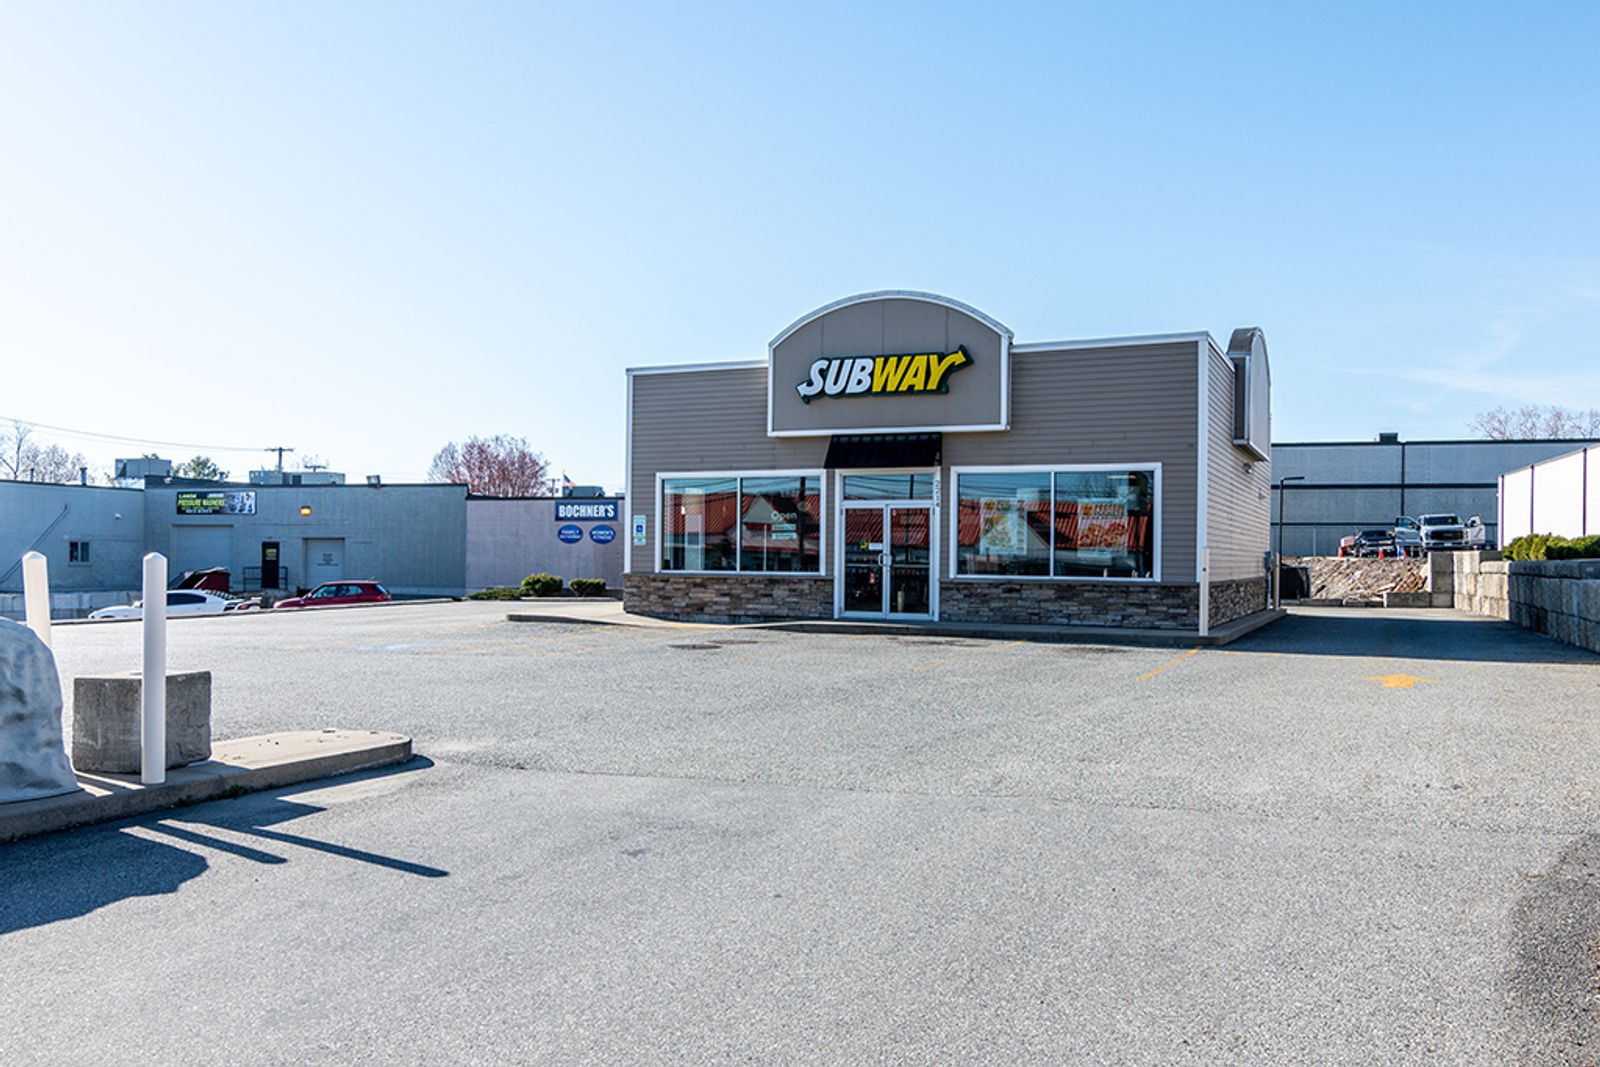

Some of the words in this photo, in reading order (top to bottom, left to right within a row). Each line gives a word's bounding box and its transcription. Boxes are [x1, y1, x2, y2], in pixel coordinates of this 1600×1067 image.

[796, 350, 966, 398] SUBWAY
[559, 504, 615, 517] BOCHNER'S
[771, 511, 797, 521] Open
